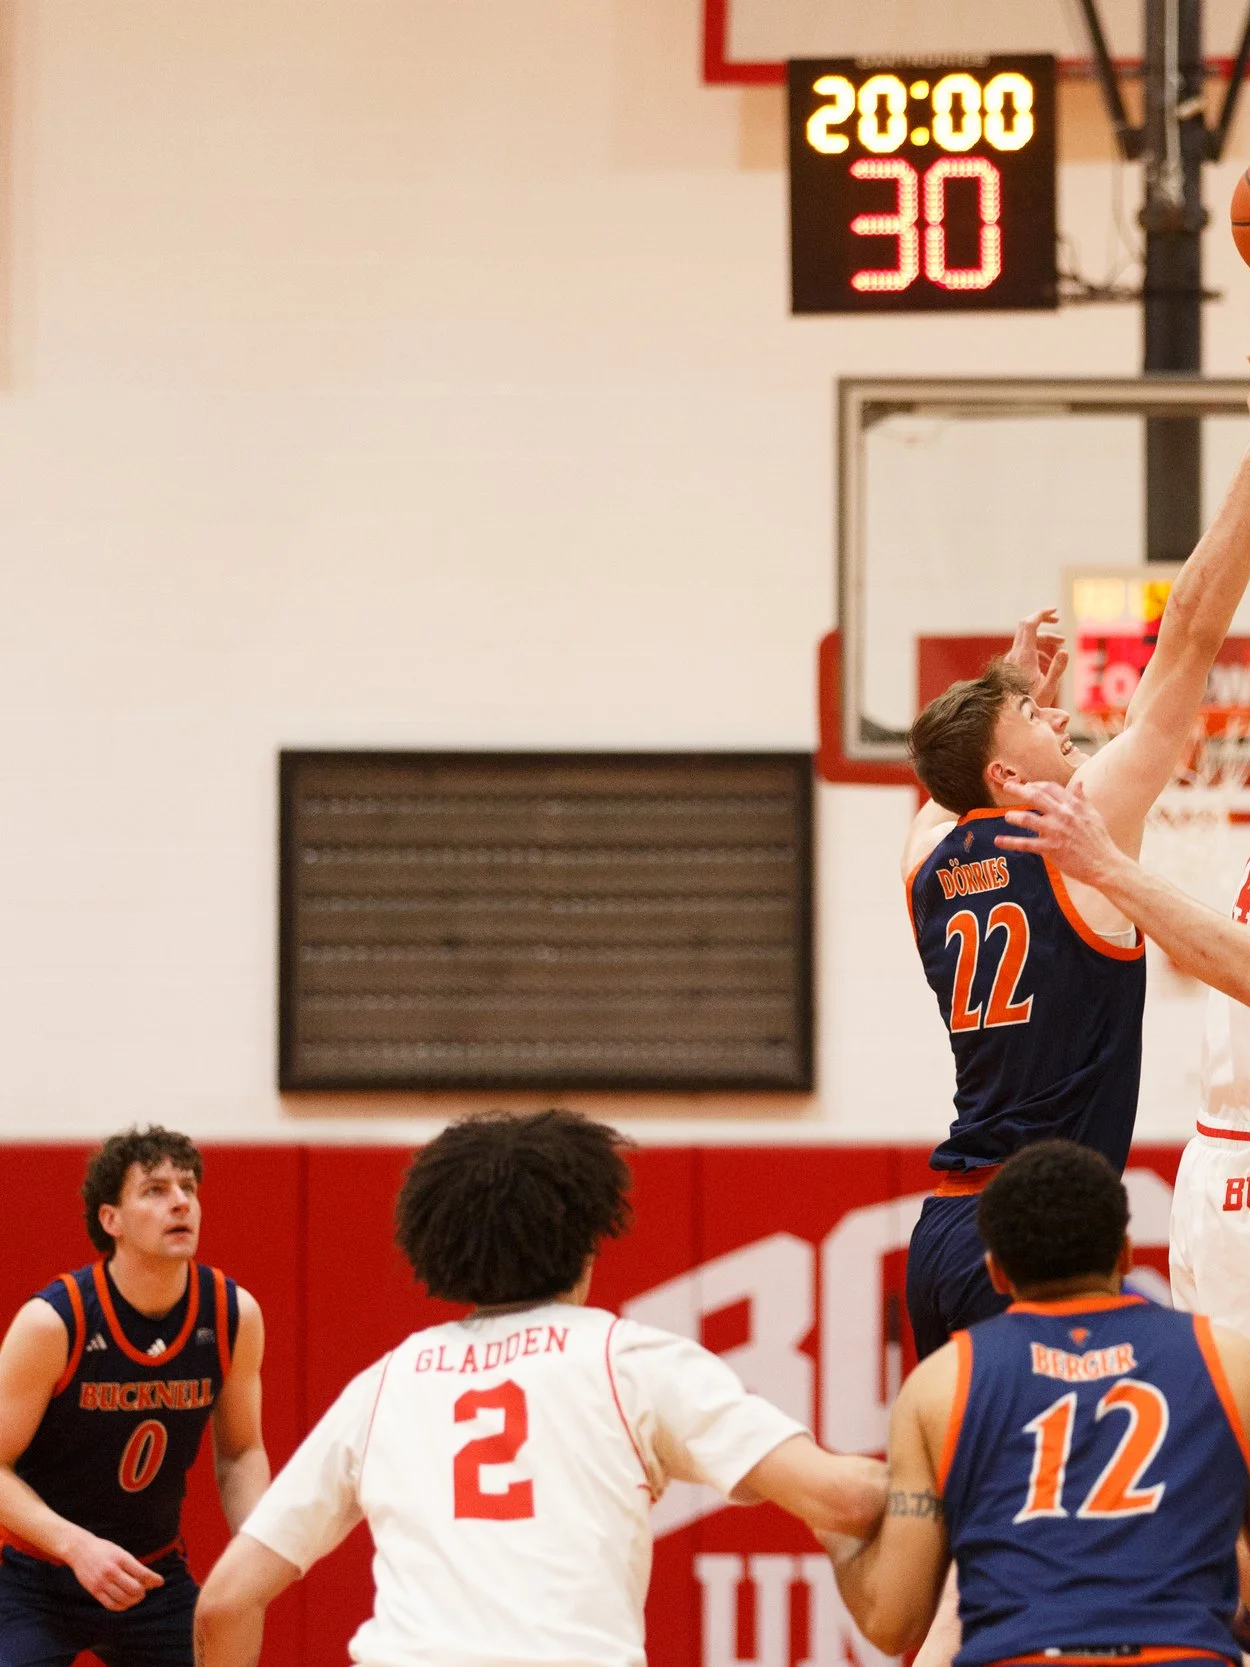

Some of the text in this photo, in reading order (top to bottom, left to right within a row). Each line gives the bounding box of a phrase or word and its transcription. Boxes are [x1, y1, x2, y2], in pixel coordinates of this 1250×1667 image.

[807, 73, 1034, 154] 20:00
[850, 158, 1001, 291] 30
[936, 856, 1009, 900] DÖRRIES
[944, 901, 1035, 1034] 22
[414, 1325, 571, 1374] GLADDEN
[1030, 1341, 1138, 1383] BERGER
[79, 1378, 214, 1412] BUCKNELL
[118, 1418, 169, 1493] 0
[453, 1379, 535, 1521] 2
[1012, 1378, 1170, 1524] 12
